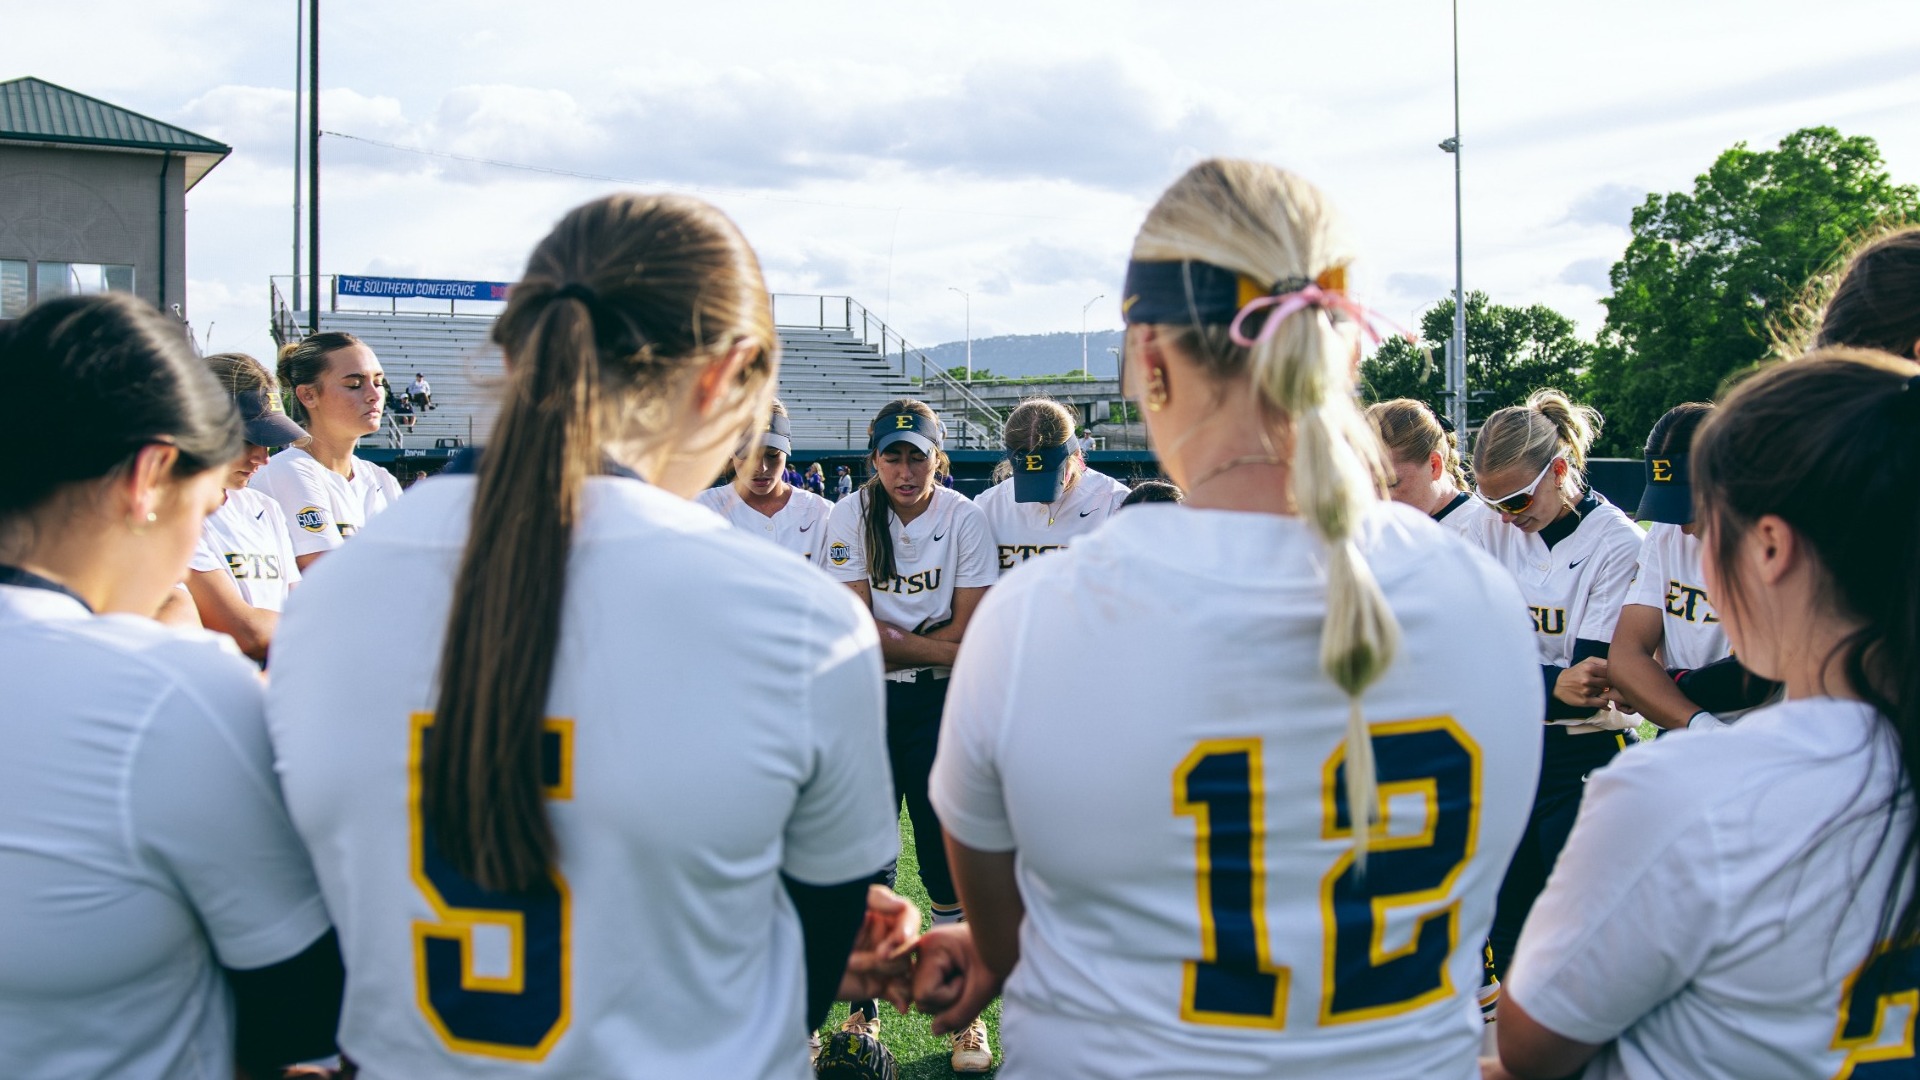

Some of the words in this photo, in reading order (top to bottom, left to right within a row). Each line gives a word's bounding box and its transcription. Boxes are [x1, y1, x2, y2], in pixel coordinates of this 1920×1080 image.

[344, 279, 362, 293] THE
[363, 280, 414, 295] SOUTHERN
[415, 282, 476, 297] CONFERENCE
[895, 415, 913, 429] E
[1026, 454, 1043, 471] E
[1652, 459, 1672, 481] E
[224, 551, 284, 580] ETS
[1171, 713, 1483, 1031] 12
